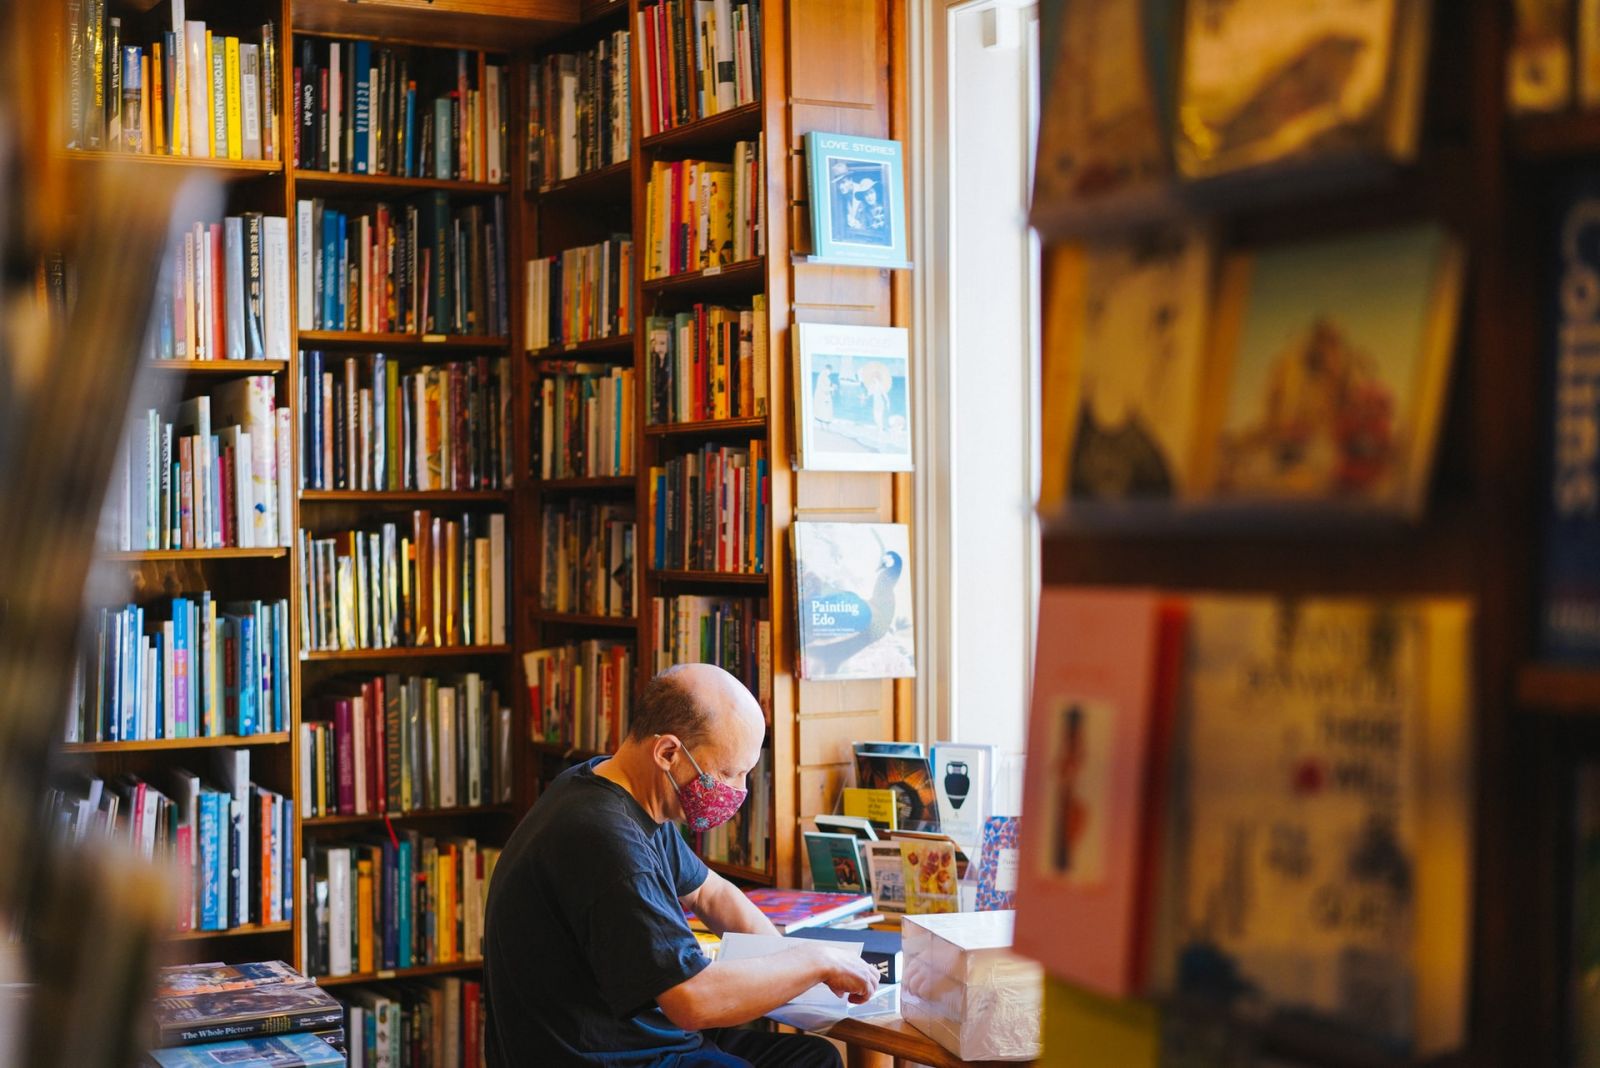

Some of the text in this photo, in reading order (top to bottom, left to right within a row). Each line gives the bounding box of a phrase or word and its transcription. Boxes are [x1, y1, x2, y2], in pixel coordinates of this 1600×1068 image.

[214, 58, 223, 89] STORY
[304, 84, 314, 126] Celtic Art
[356, 81, 369, 133] OCEANIA
[215, 93, 225, 140] PAINTING
[820, 139, 896, 156] LOVE STORIES
[250, 218, 259, 233] THE
[250, 234, 259, 254] BLUE
[812, 600, 859, 616] Painting
[812, 613, 835, 626] Edo
[388, 696, 400, 789] NAPOLEON
[182, 1025, 255, 1040] The Whole Picture
